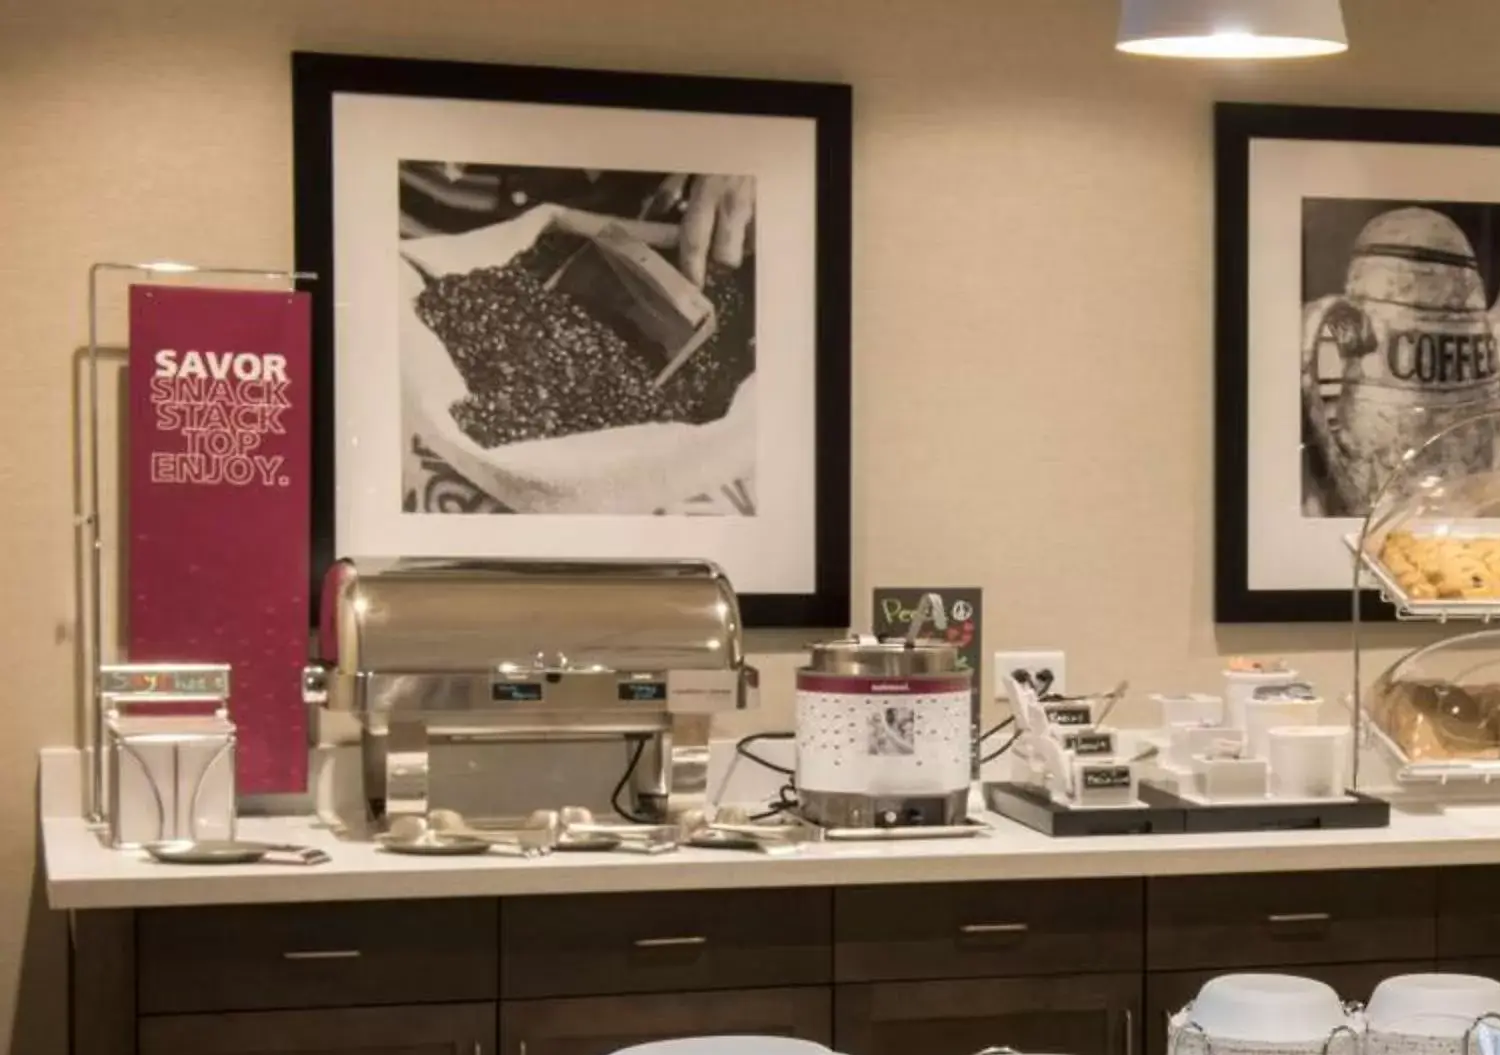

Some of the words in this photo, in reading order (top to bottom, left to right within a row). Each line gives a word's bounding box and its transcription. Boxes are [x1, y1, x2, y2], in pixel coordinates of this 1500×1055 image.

[155, 349, 287, 381] SAVOR
[150, 377, 292, 408] SNACK
[156, 402, 286, 434] STACK
[181, 428, 260, 456] TOP
[151, 452, 290, 486] ENJOY.
